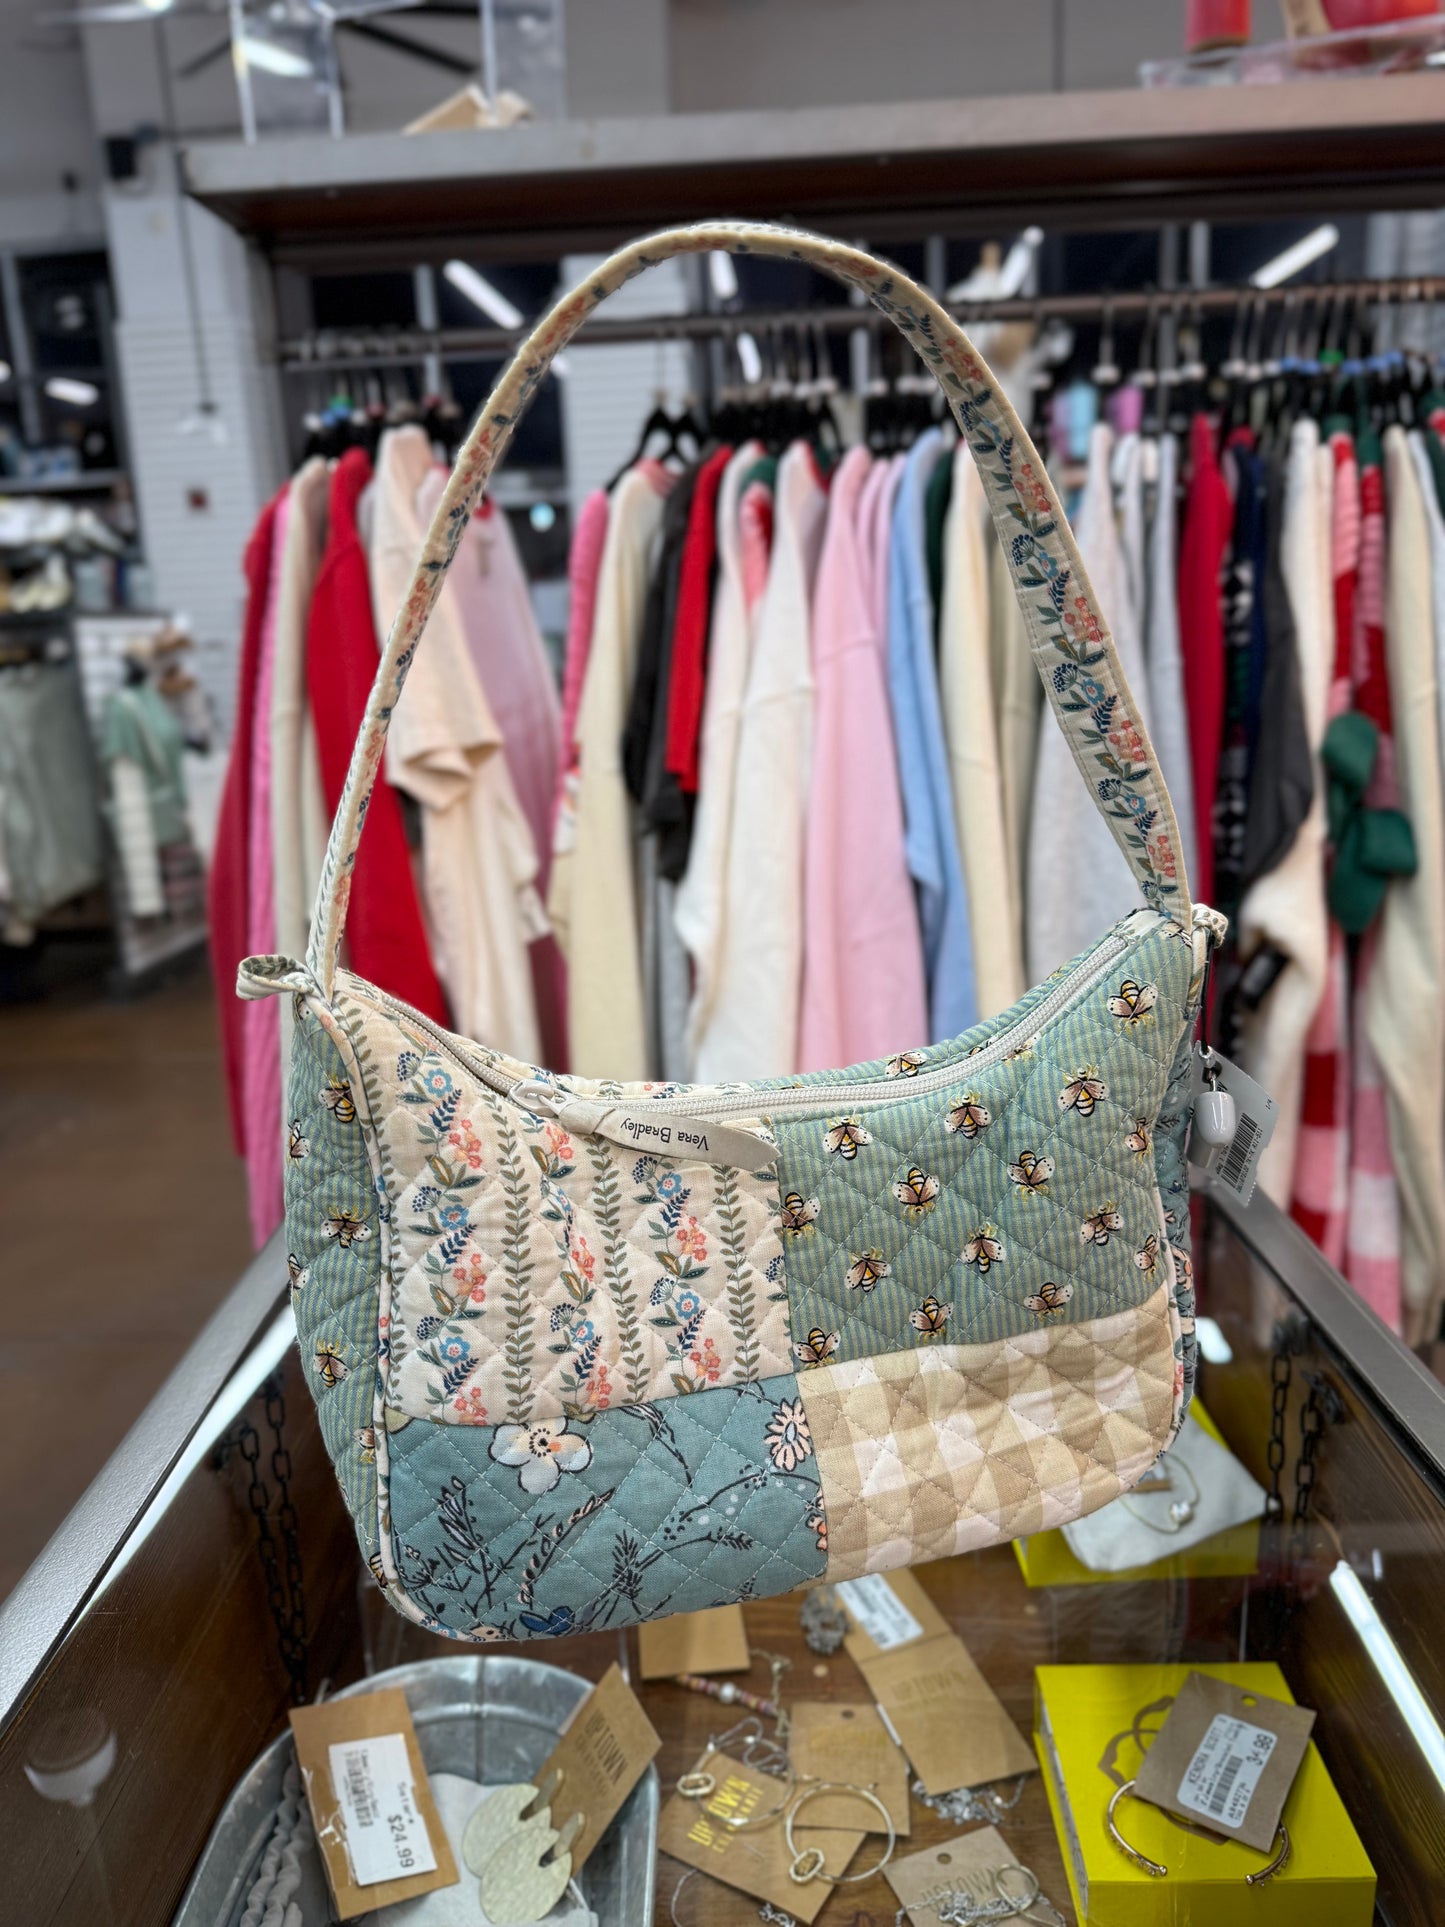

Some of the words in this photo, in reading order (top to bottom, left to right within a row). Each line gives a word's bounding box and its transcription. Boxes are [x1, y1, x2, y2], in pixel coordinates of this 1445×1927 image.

[620, 1117, 672, 1144] Bradley
[677, 1131, 710, 1151] Vera
[686, 1774, 751, 1847] UPOWN
[387, 1814, 416, 1869] $24.99
